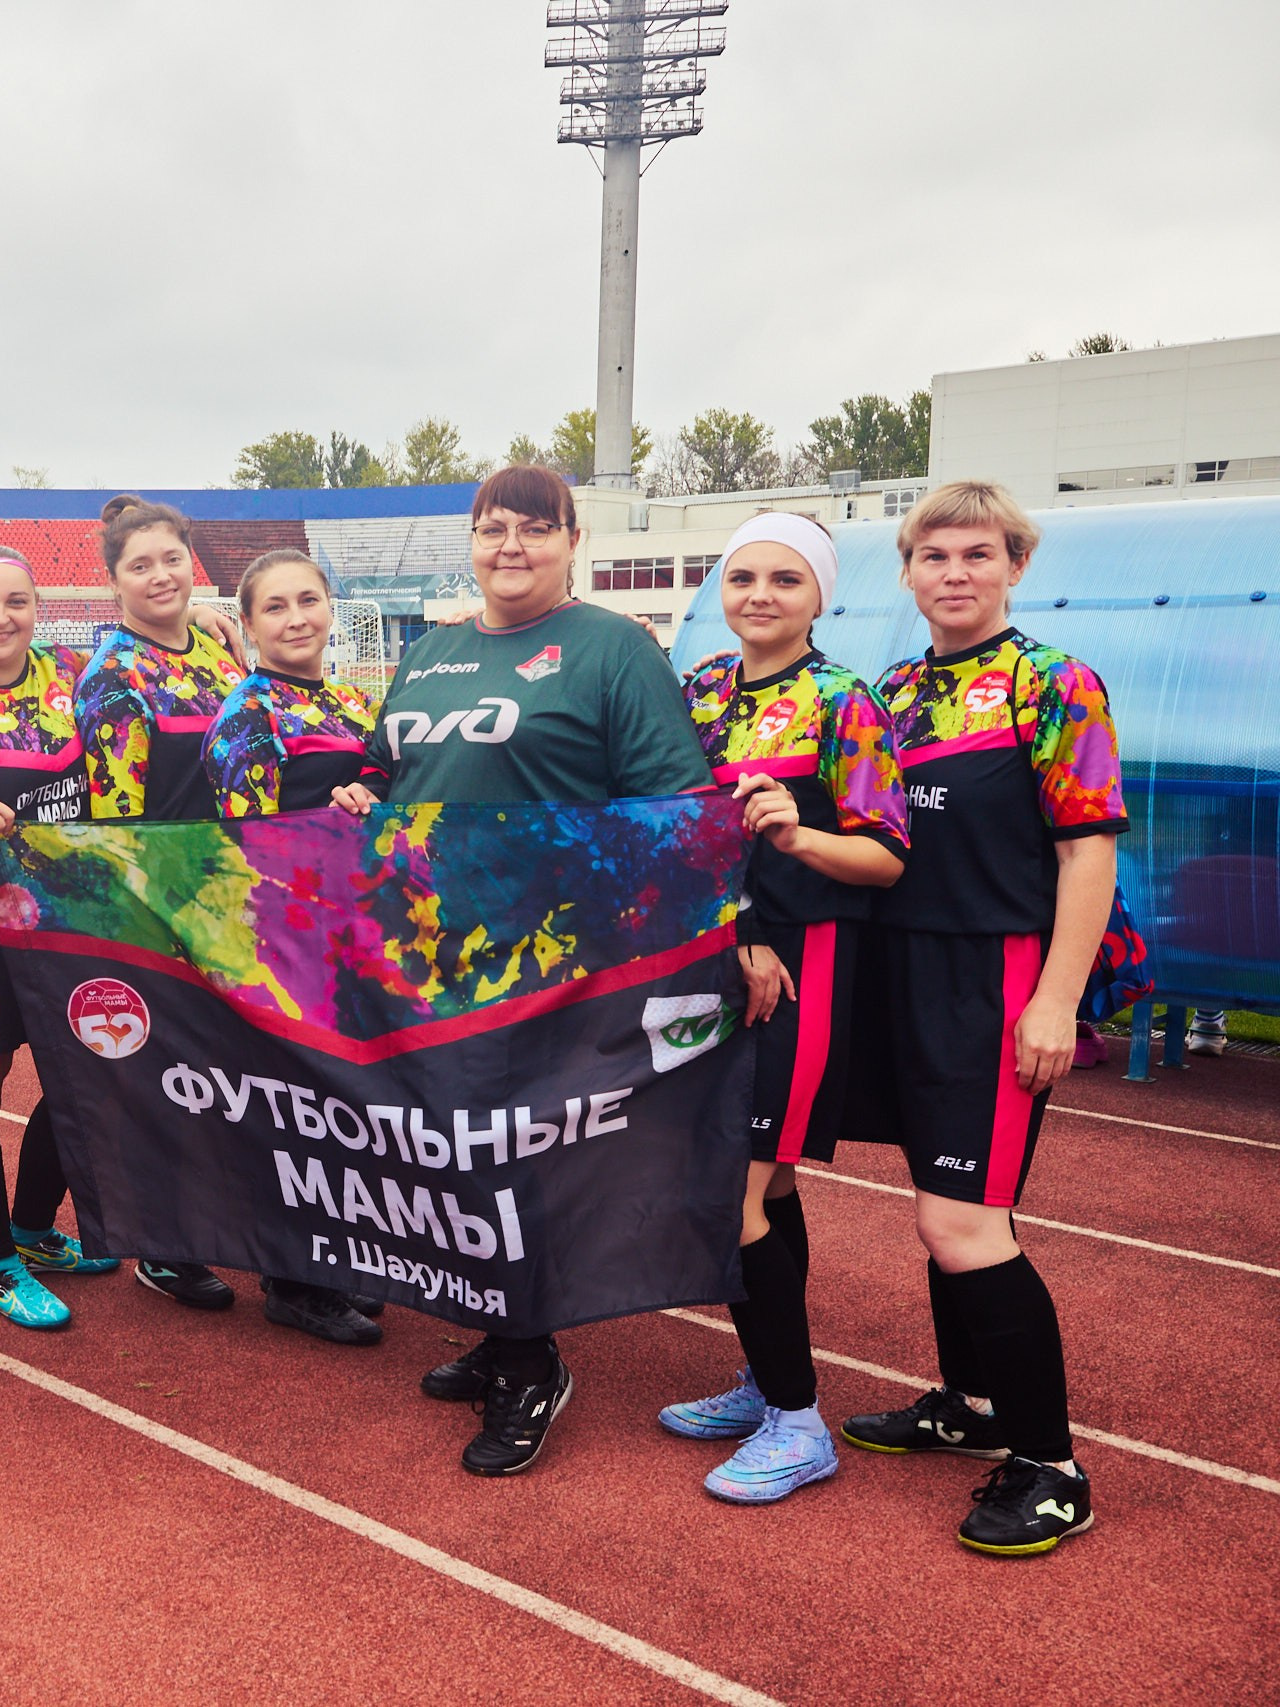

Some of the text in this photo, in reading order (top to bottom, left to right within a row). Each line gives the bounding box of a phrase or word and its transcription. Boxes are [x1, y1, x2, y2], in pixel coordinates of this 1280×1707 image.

[757, 716, 790, 741] 52
[965, 687, 1008, 713] 52
[78, 1012, 145, 1059] 52
[161, 1062, 634, 1172] ФУТБОЛЬНЫЕ
[273, 1149, 525, 1262] МАМЫ
[312, 1234, 508, 1317] г. Шахунья
